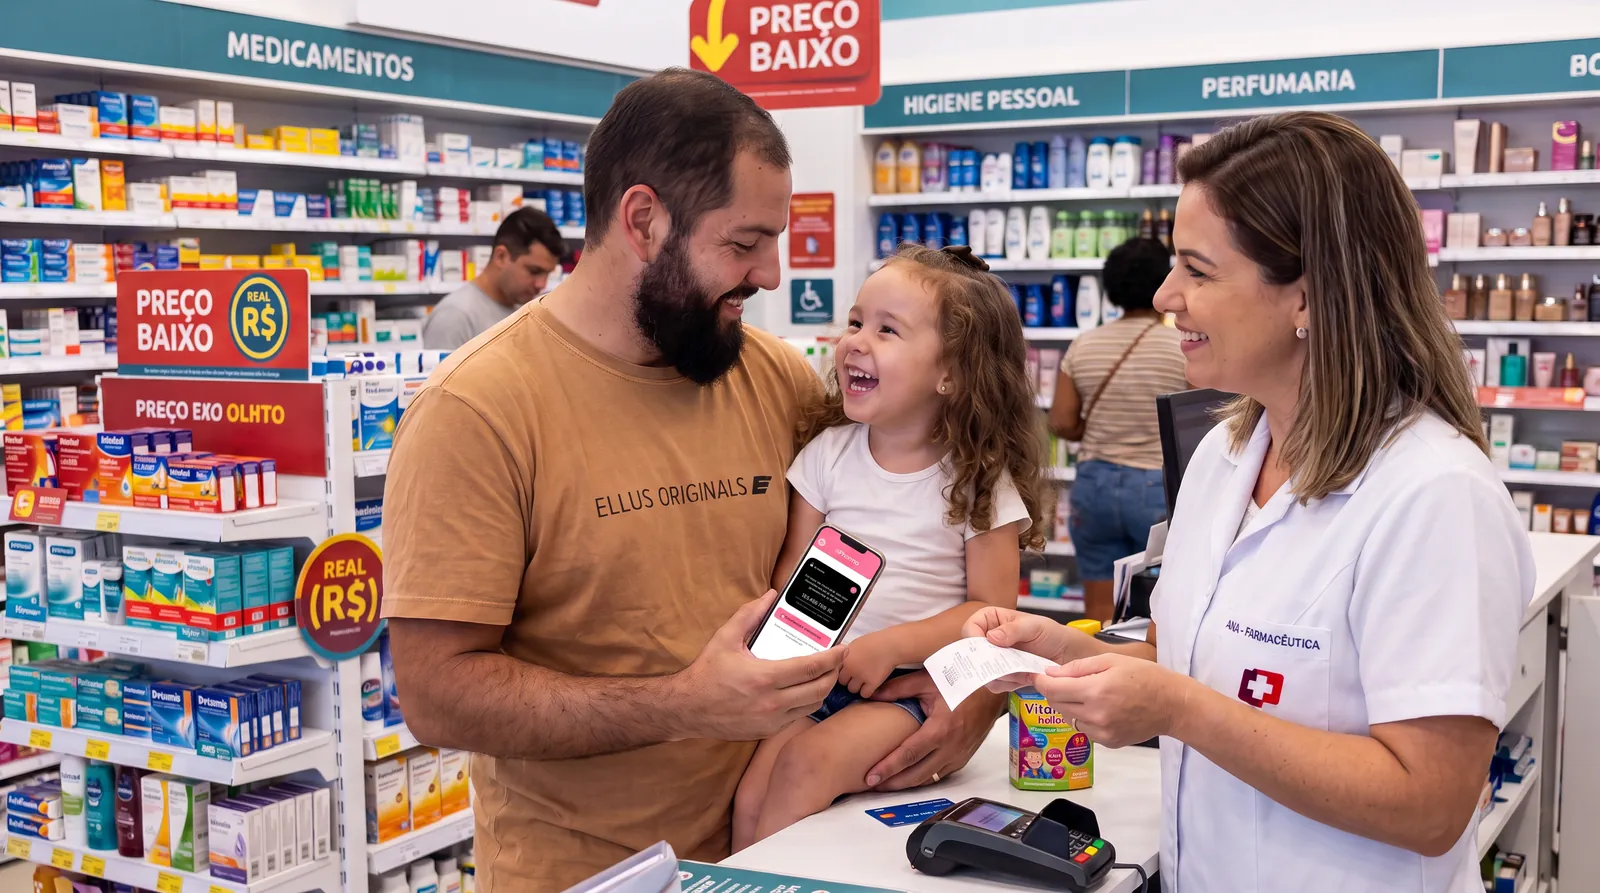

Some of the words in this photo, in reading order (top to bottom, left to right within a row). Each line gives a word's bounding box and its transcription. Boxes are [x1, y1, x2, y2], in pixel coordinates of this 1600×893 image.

[750, 0, 860, 37] PREÇO
[227, 31, 414, 81] MEDICAMENTOS
[750, 35, 860, 72] BAIXO
[1202, 68, 1355, 99] PERFUMARIA
[904, 91, 984, 115] HIGIENE
[987, 86, 1080, 110] PESSOAL
[136, 288, 213, 322] PREÇO
[247, 291, 271, 302] REAL
[137, 323, 214, 352] BAIXO
[242, 303, 277, 341] R$
[135, 399, 189, 424] PREÇO
[192, 401, 223, 422] EXO
[226, 402, 285, 425] OLHTO
[595, 488, 654, 518] ELLUS
[658, 477, 747, 507] ORIGINALS
[323, 558, 367, 579] REAL
[1226, 620, 1239, 633] ANA
[1244, 627, 1320, 650] FARMACÊUTICA
